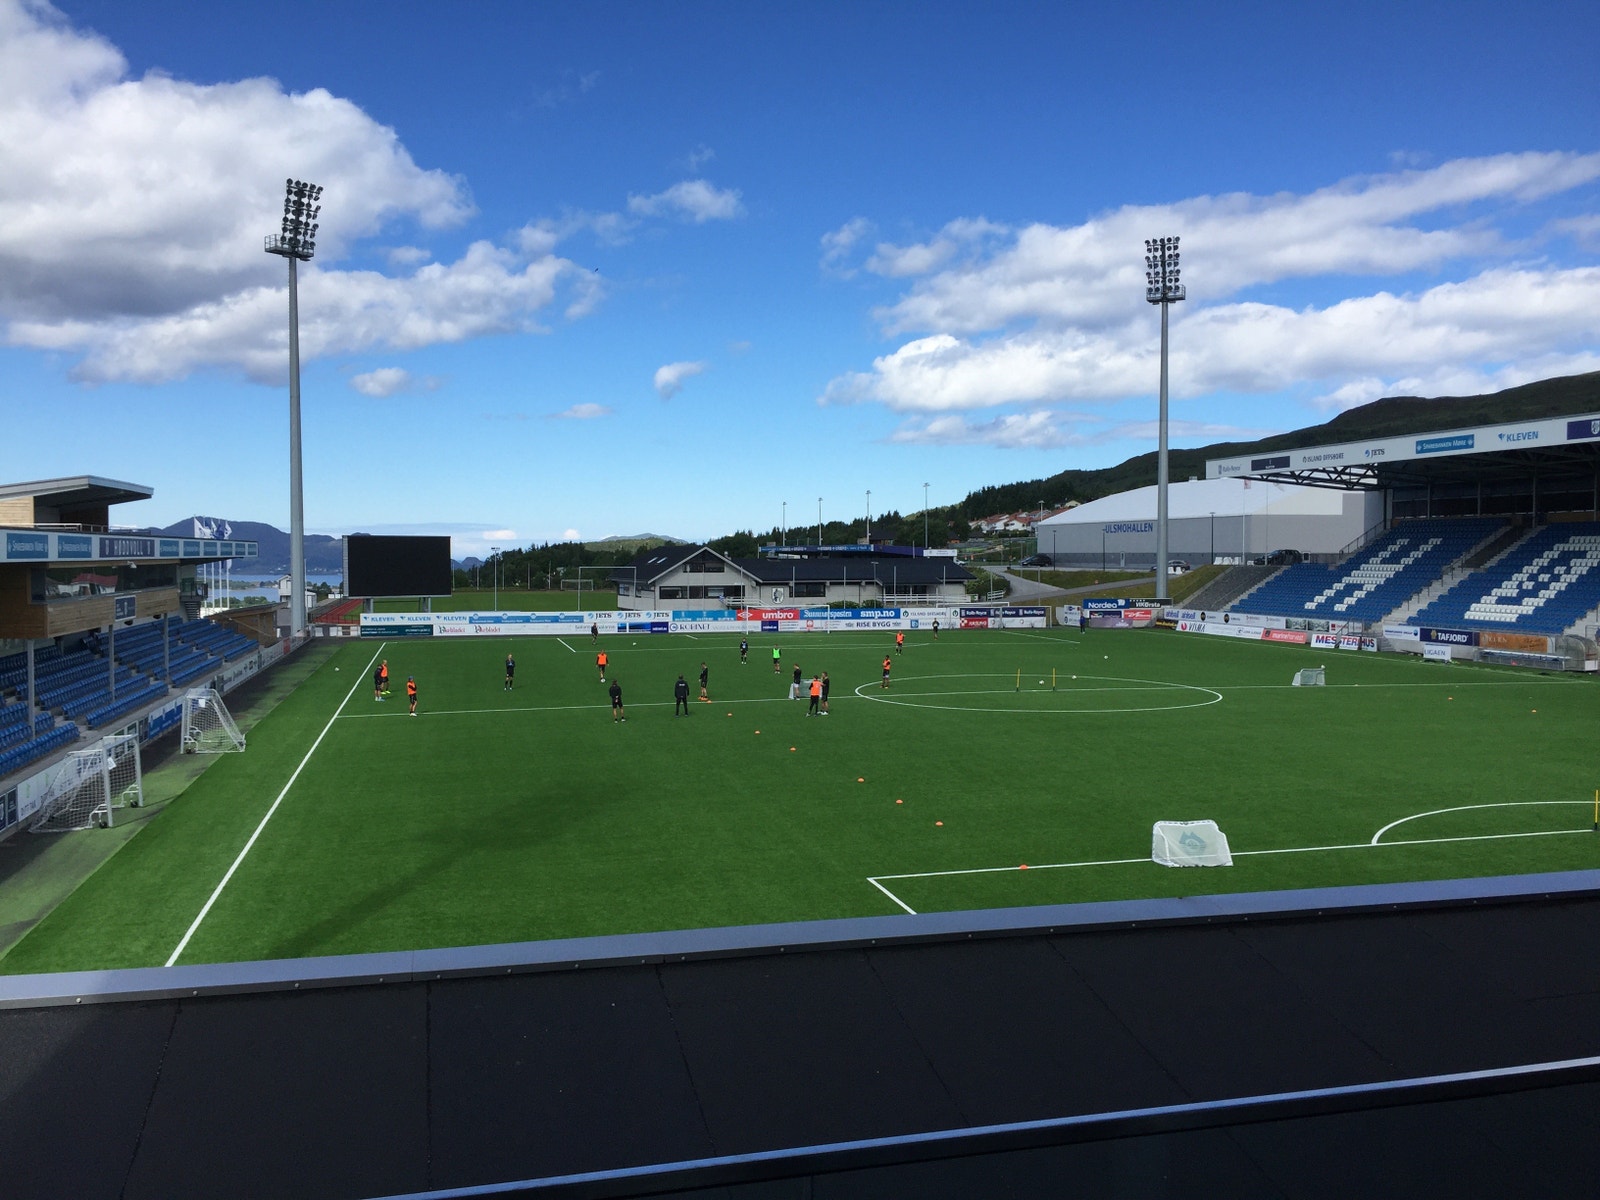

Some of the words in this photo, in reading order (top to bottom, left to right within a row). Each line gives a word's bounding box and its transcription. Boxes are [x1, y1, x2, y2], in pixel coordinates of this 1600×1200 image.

[1506, 431, 1539, 442] KLEVEN
[1323, 453, 1344, 461] OFFSHORE
[1371, 449, 1385, 458] JETS
[1105, 522, 1153, 534] ULSMOHALLEN
[762, 611, 794, 619] umbro
[861, 609, 895, 619] smp.no
[1189, 622, 1206, 633] VISMA
[1438, 632, 1467, 643] TAFJORD
